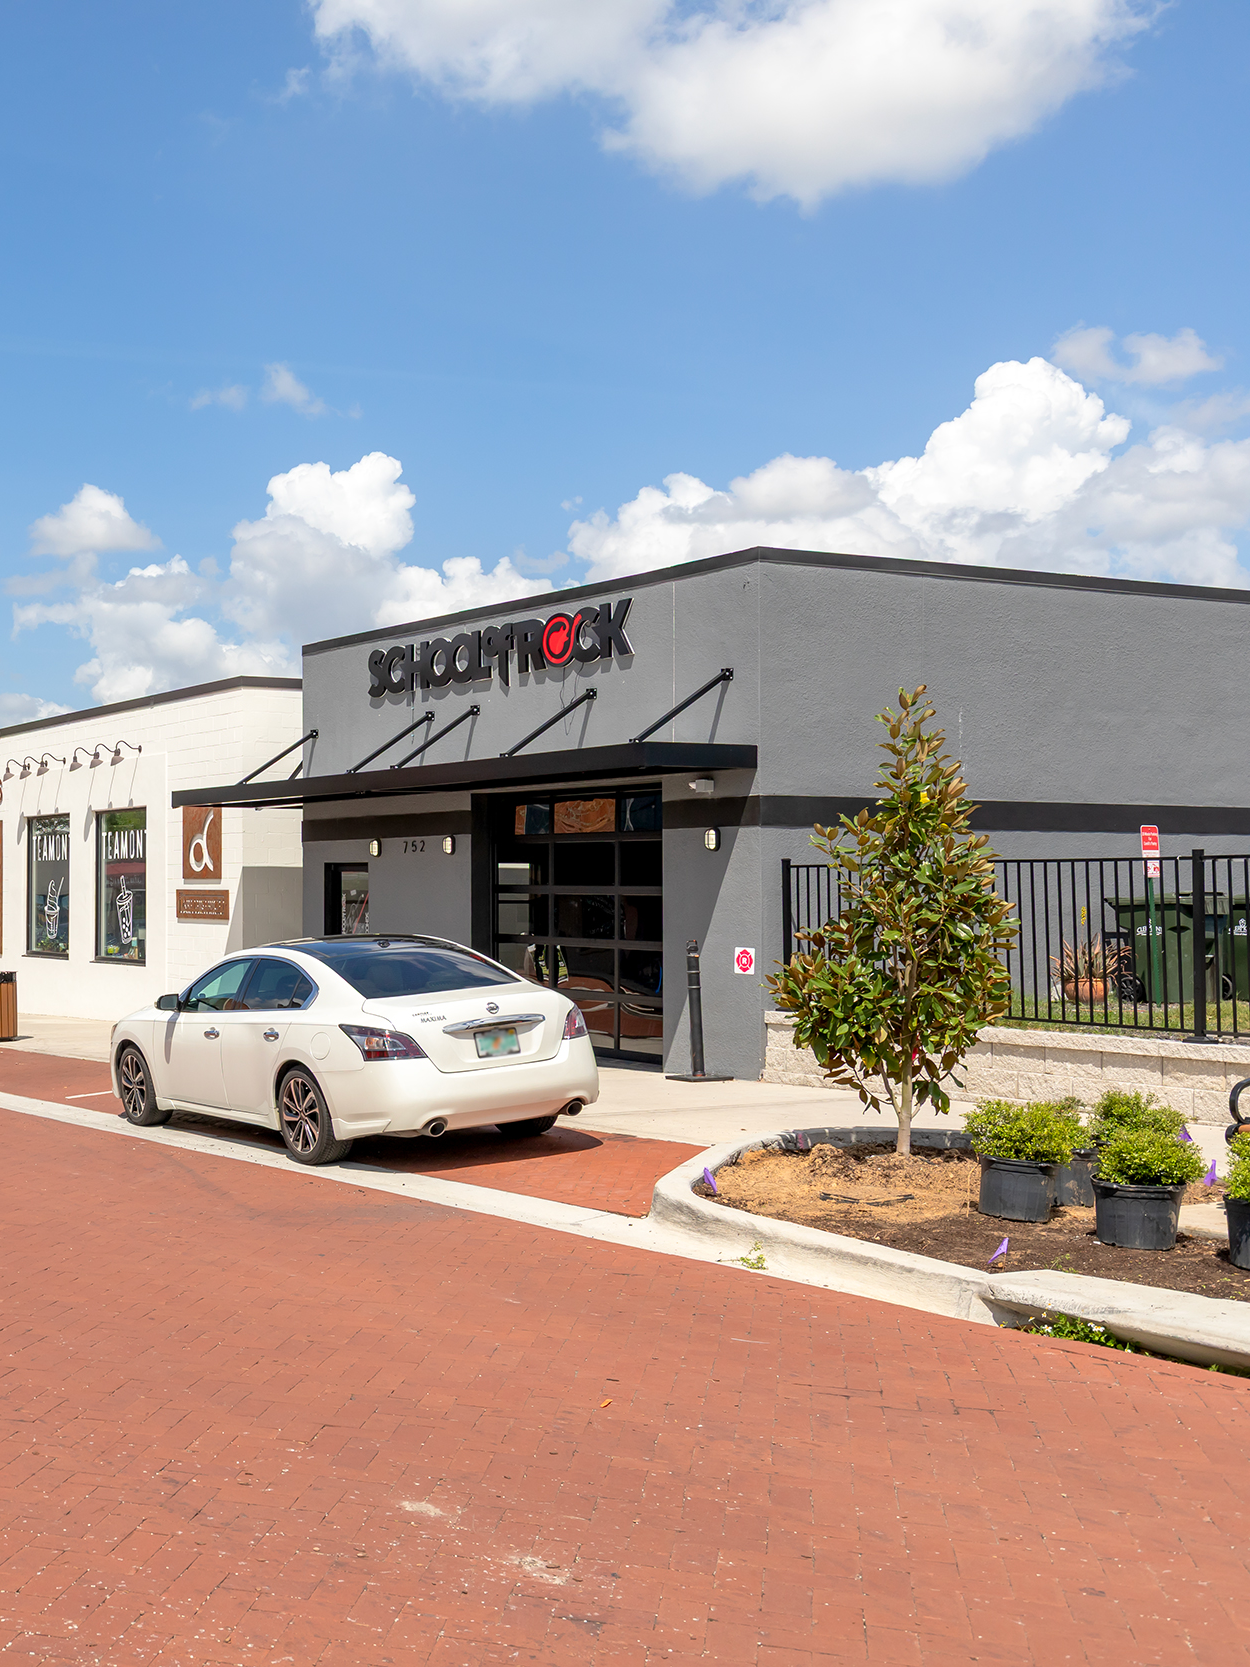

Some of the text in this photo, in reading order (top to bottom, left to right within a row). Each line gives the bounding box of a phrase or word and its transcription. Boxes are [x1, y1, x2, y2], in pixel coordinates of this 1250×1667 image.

[512, 598, 635, 674] ROCK
[403, 840, 425, 853] 752
[420, 1015, 447, 1024] MAXIMA
